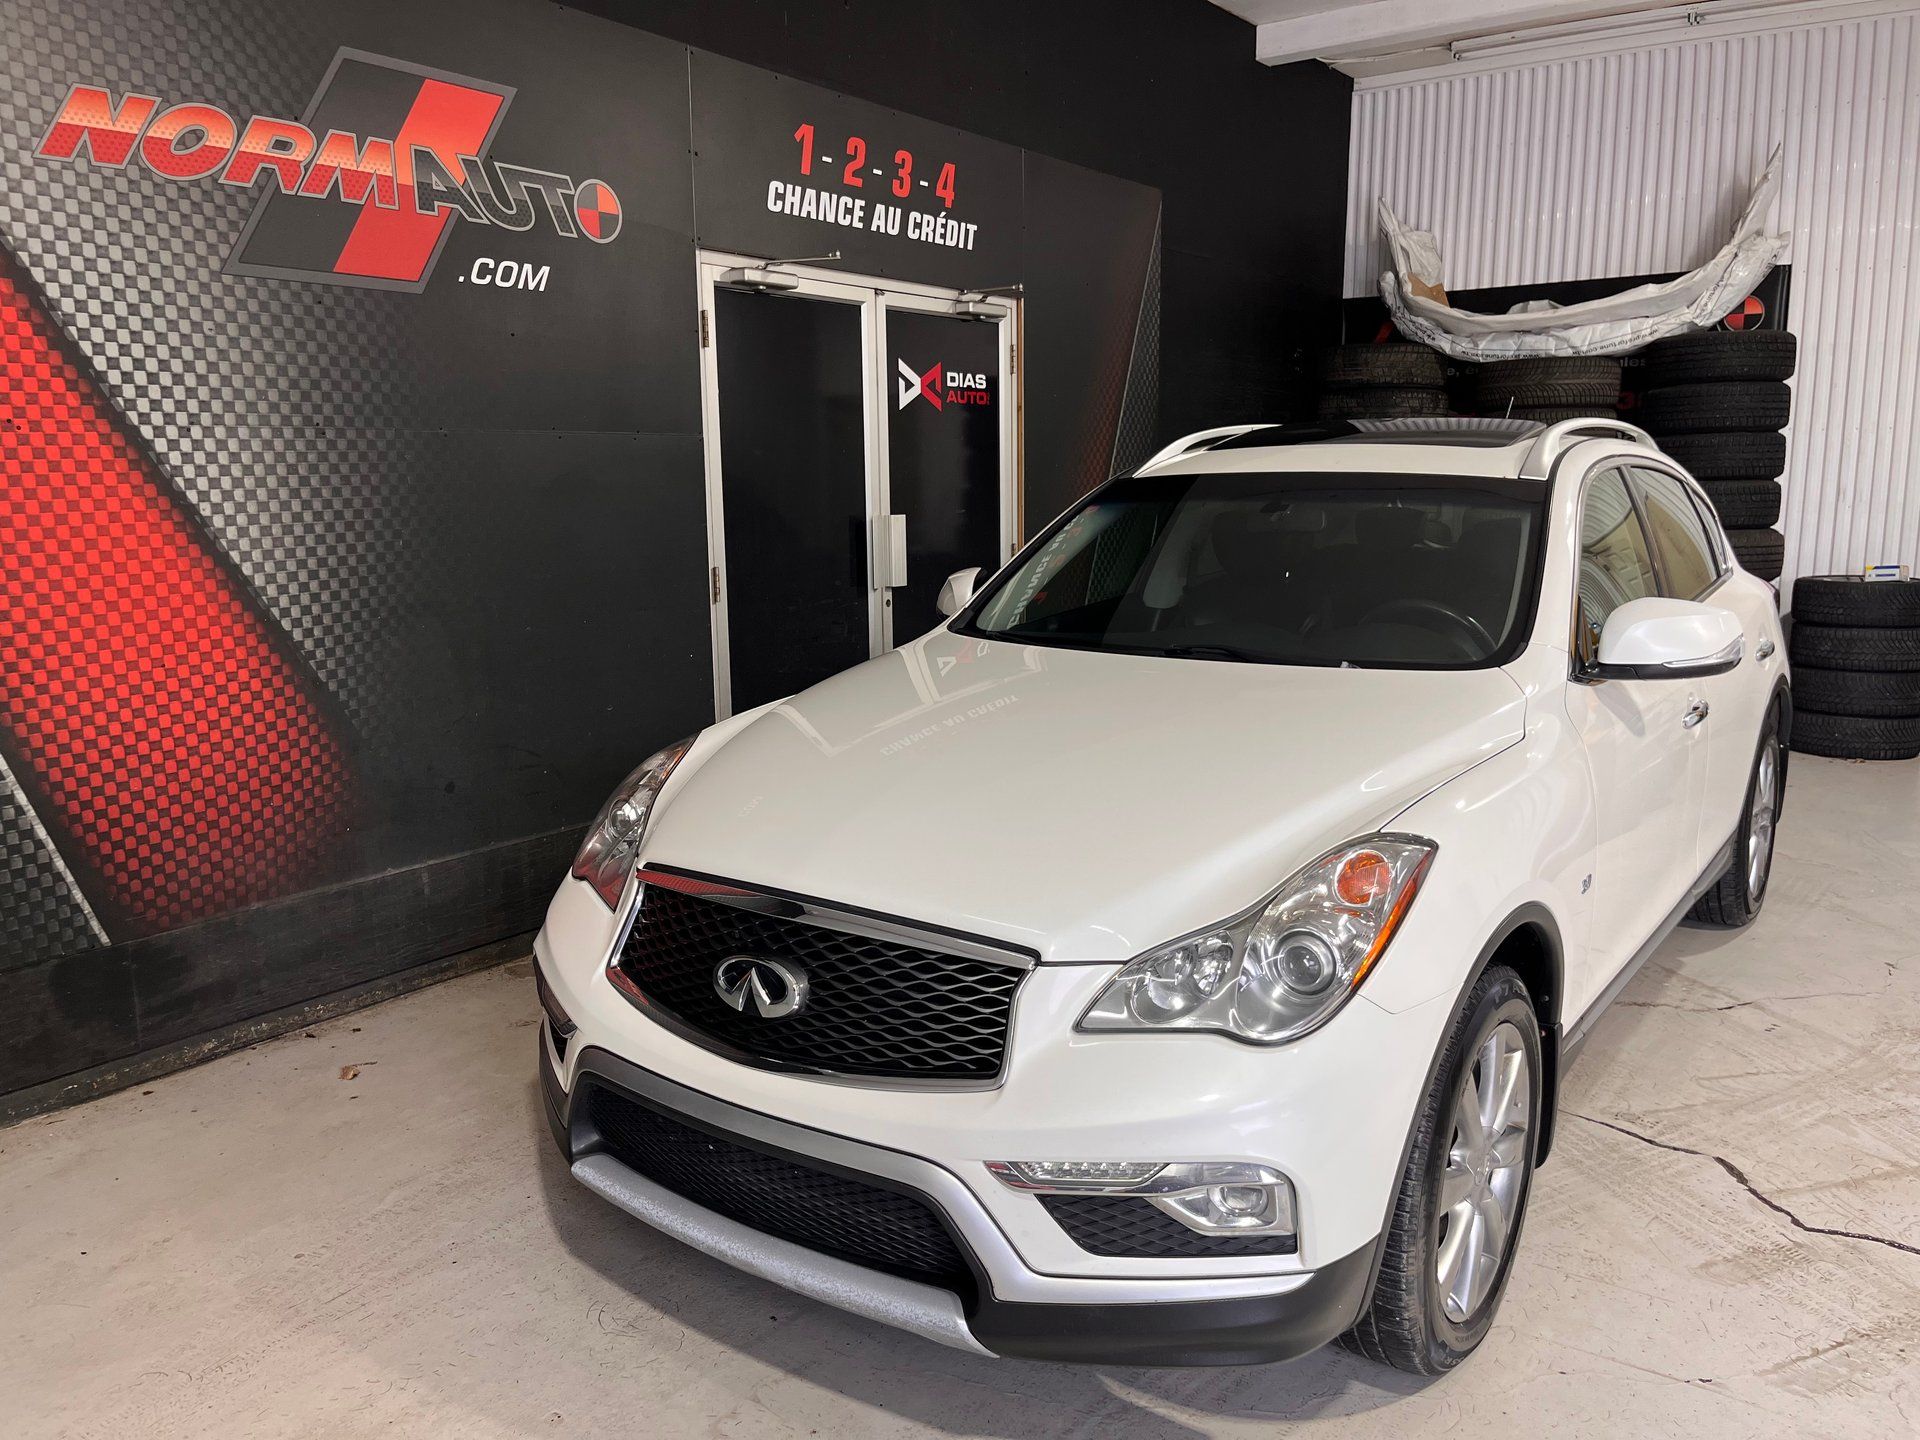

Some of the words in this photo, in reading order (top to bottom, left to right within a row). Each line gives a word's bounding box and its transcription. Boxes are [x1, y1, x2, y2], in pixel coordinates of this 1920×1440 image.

[767, 180, 866, 229] CHANCE
[870, 203, 902, 236] AU
[907, 211, 978, 251] CRÉDIT
[458, 257, 551, 292] .COM
[946, 371, 987, 389] DIAS
[946, 390, 988, 405] AUTO
